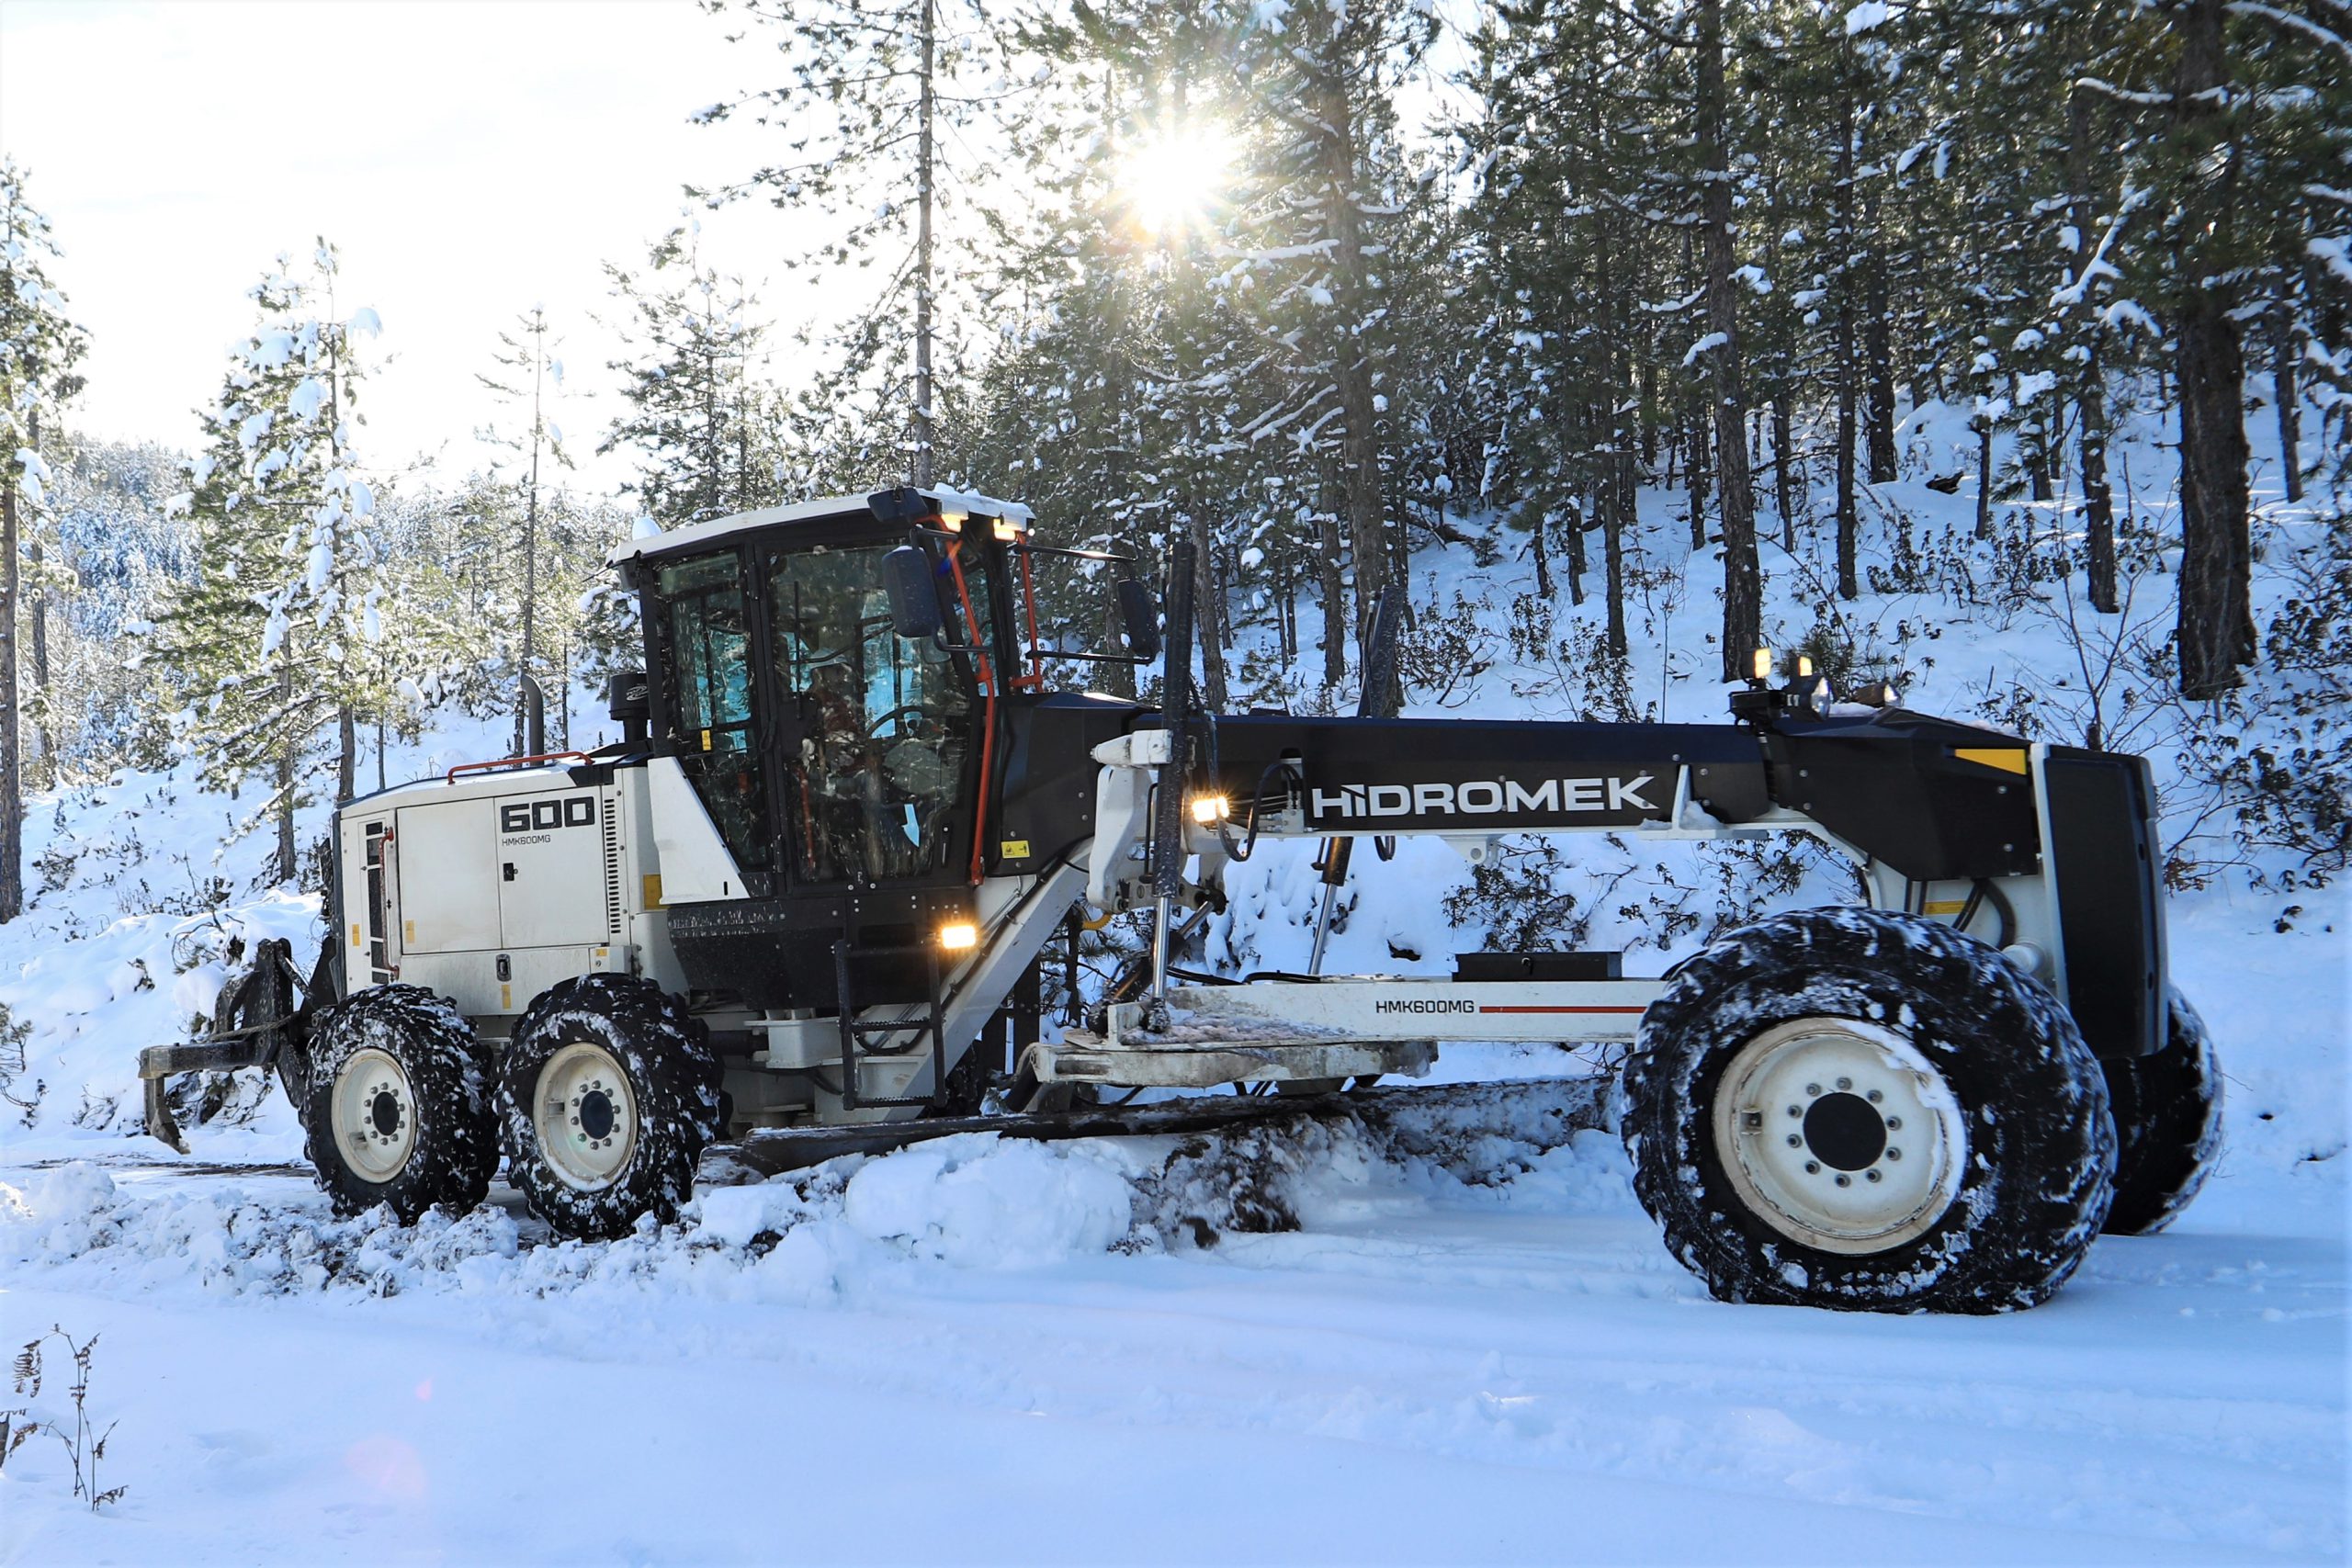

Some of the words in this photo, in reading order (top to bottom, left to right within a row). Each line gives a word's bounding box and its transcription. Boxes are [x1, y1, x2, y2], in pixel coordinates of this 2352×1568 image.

[501, 796, 595, 833] 600
[502, 834, 551, 847] HMK600MG
[1375, 999, 1475, 1014] HMK600MG
